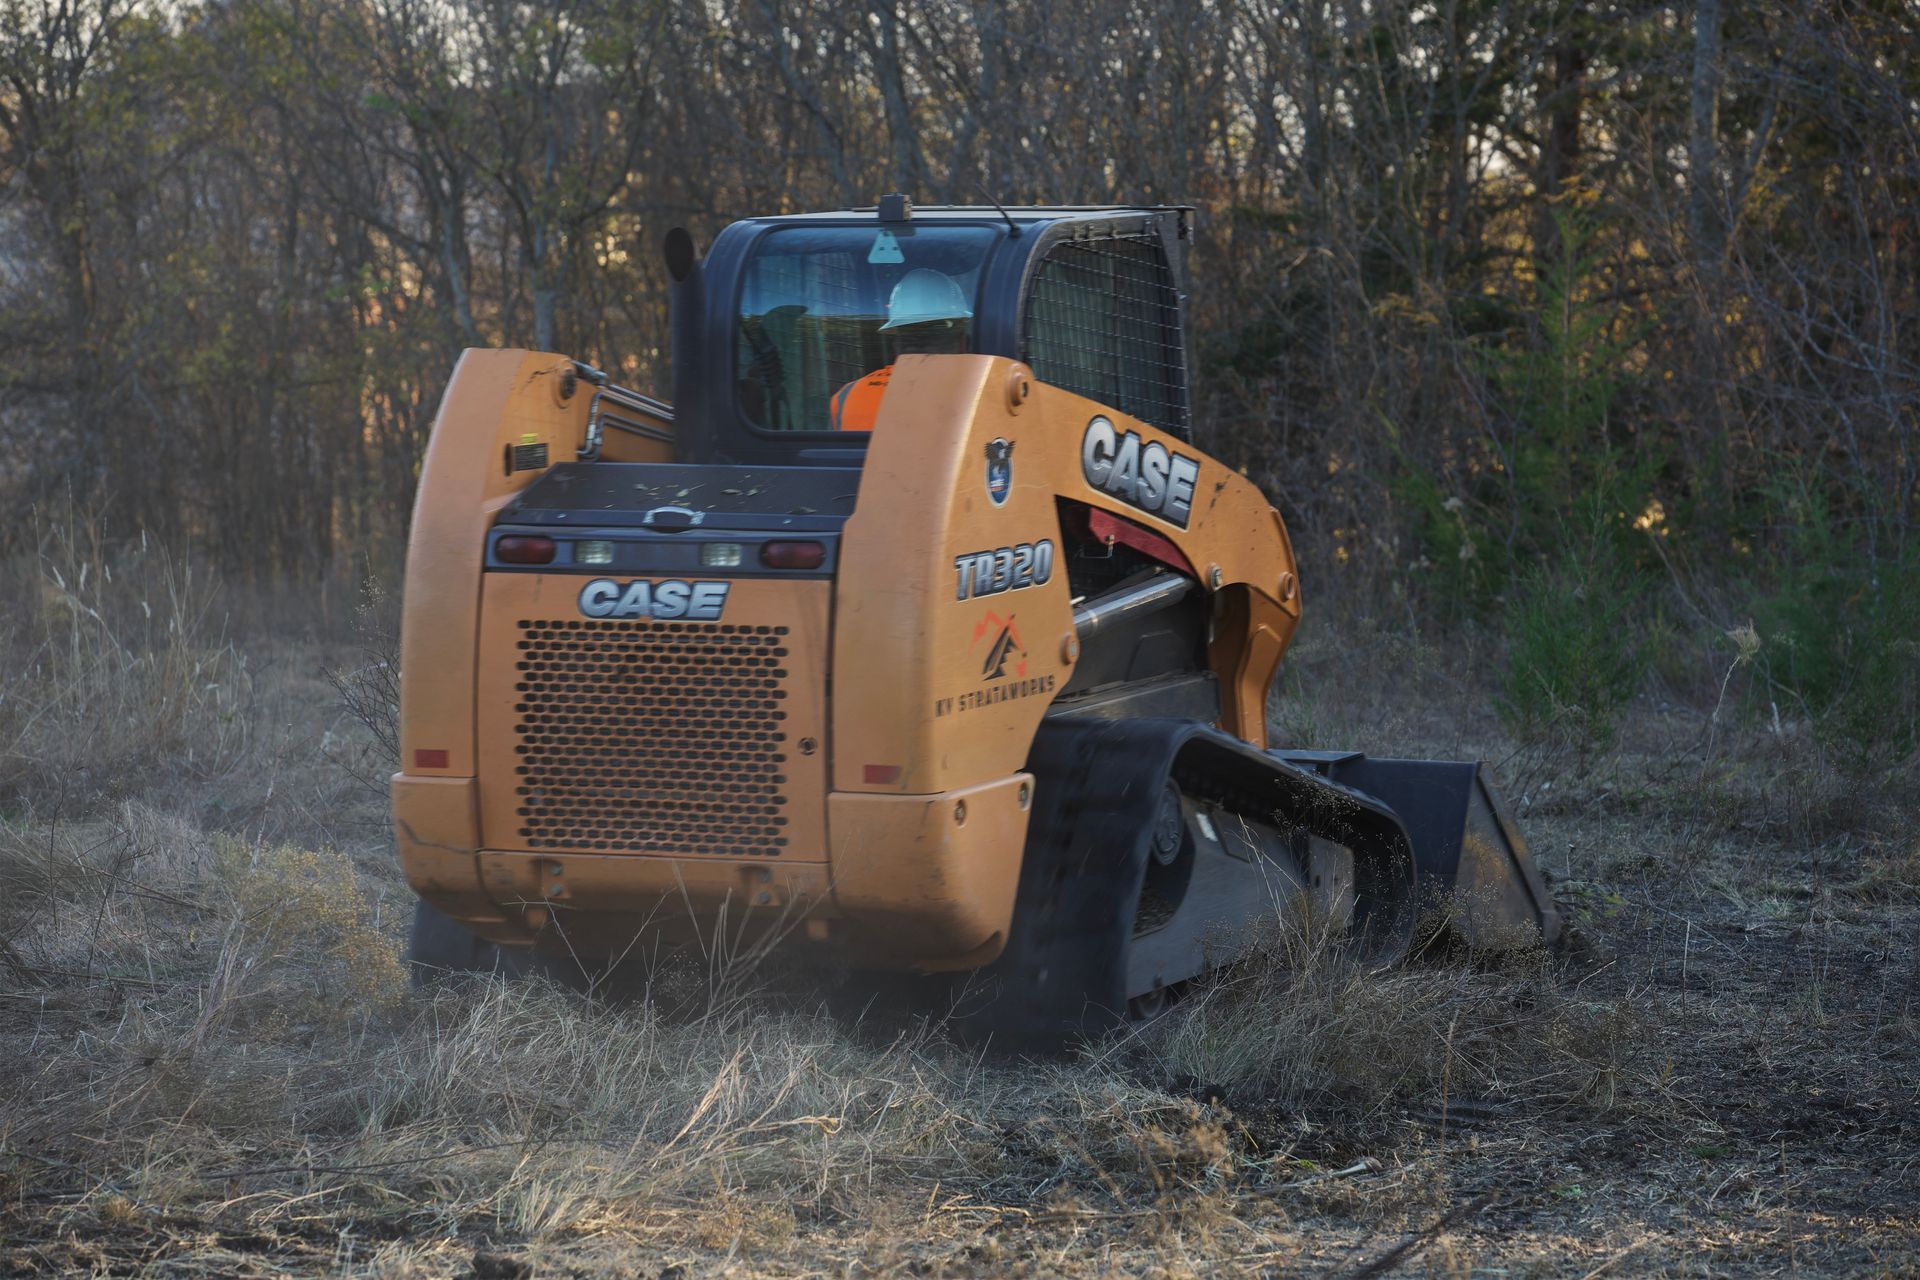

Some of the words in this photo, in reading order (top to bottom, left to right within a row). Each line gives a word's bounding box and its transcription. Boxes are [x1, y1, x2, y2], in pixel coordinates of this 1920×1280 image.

[1082, 415, 1199, 531] CASE
[578, 578, 731, 621] CASE
[954, 538, 1053, 602] TR320
